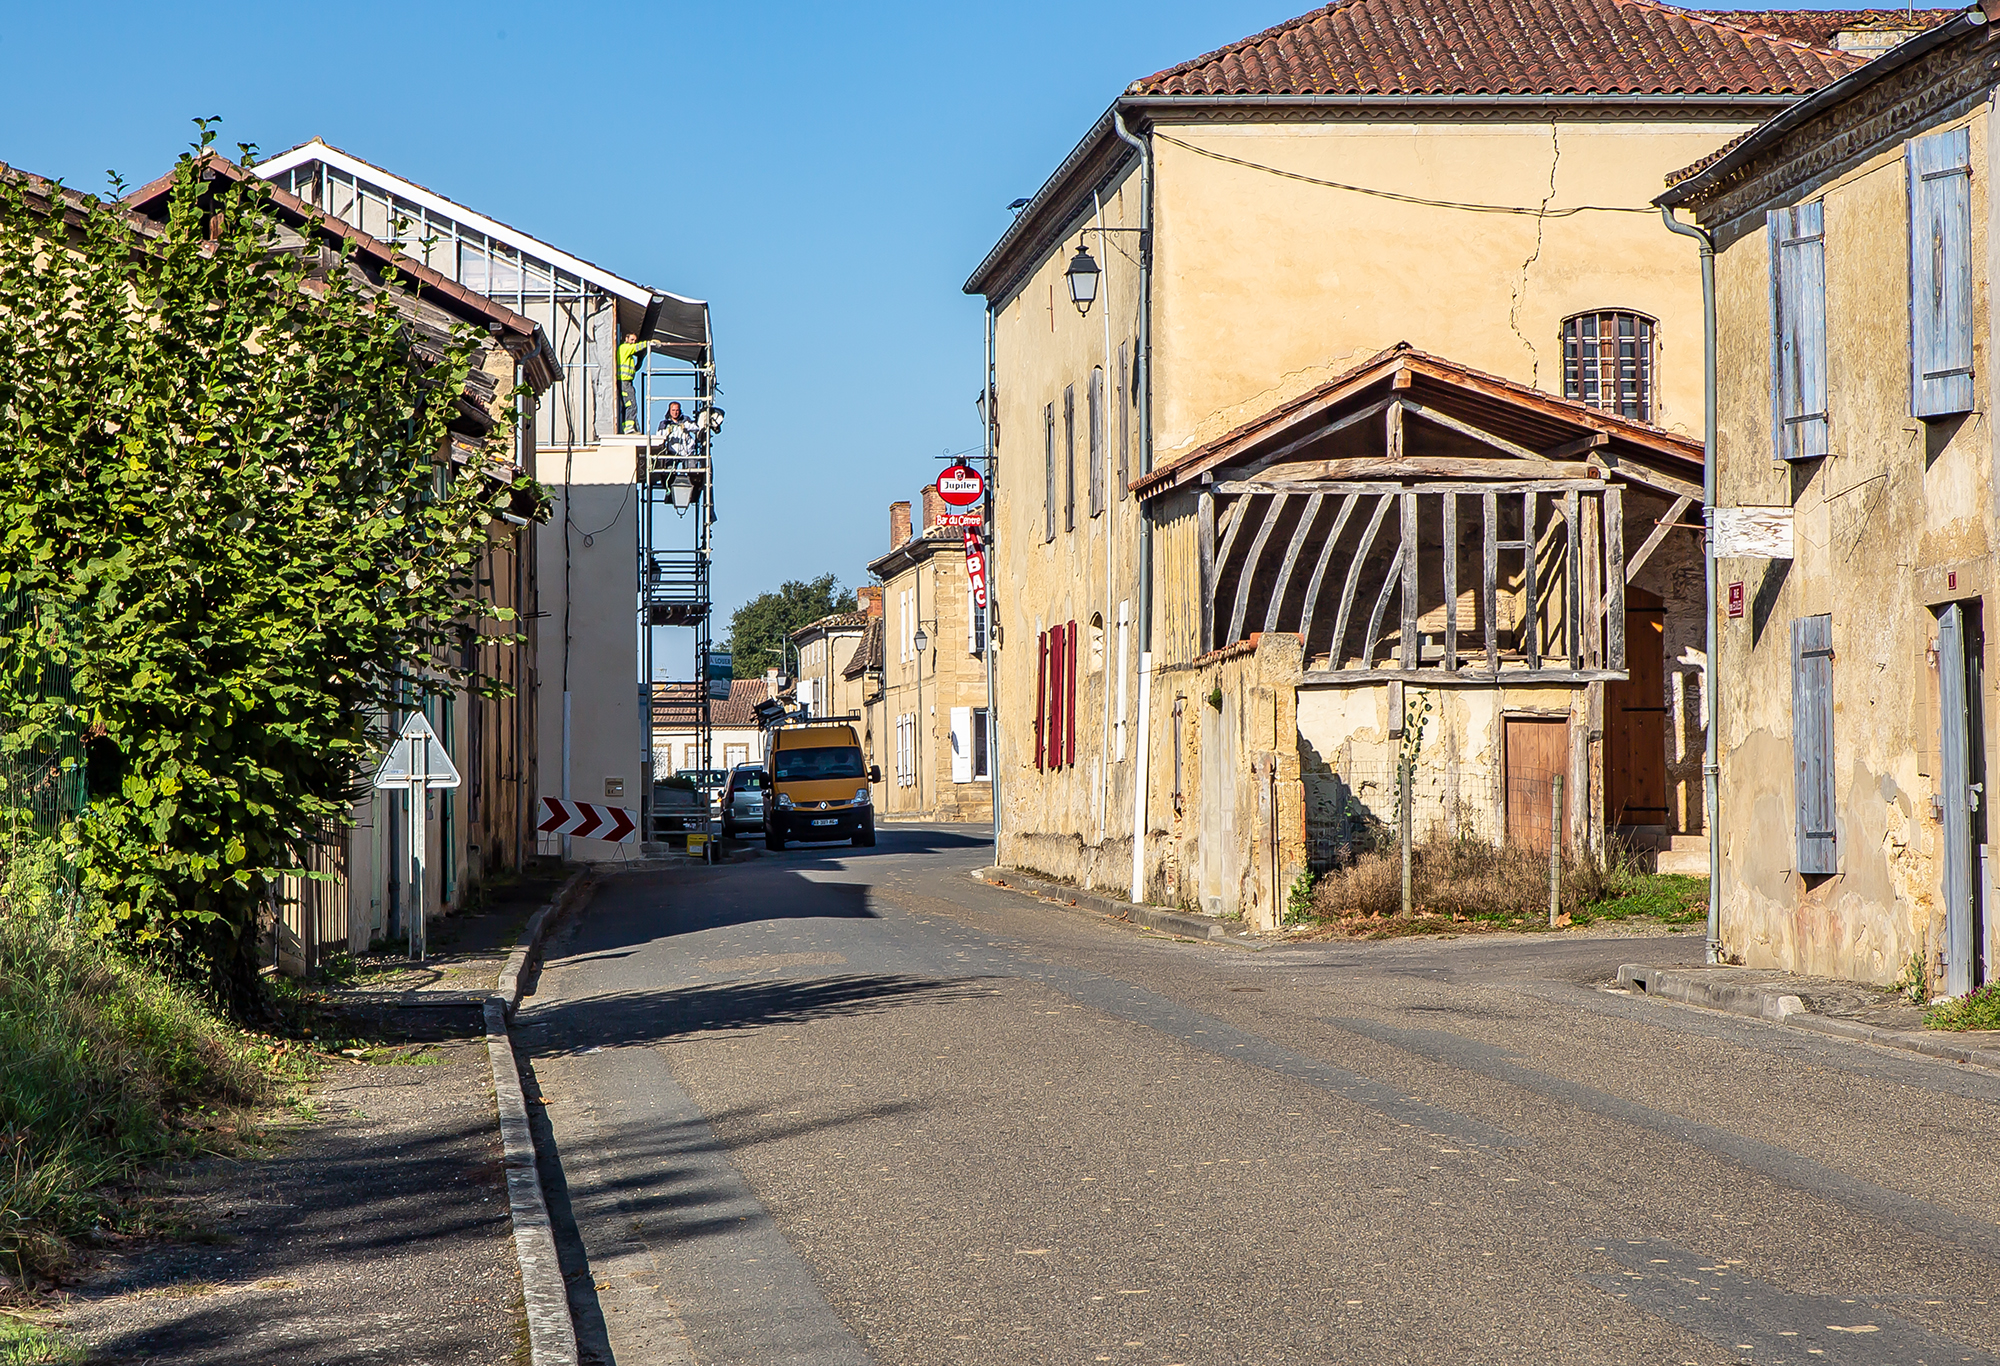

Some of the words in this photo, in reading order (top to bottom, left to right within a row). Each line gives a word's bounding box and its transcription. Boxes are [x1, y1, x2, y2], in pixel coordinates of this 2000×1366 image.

[944, 481, 977, 490] Jupiler
[936, 515, 948, 525] Bar
[949, 515, 957, 525] du
[958, 515, 981, 526] Centre
[963, 526, 986, 605] TABAC
